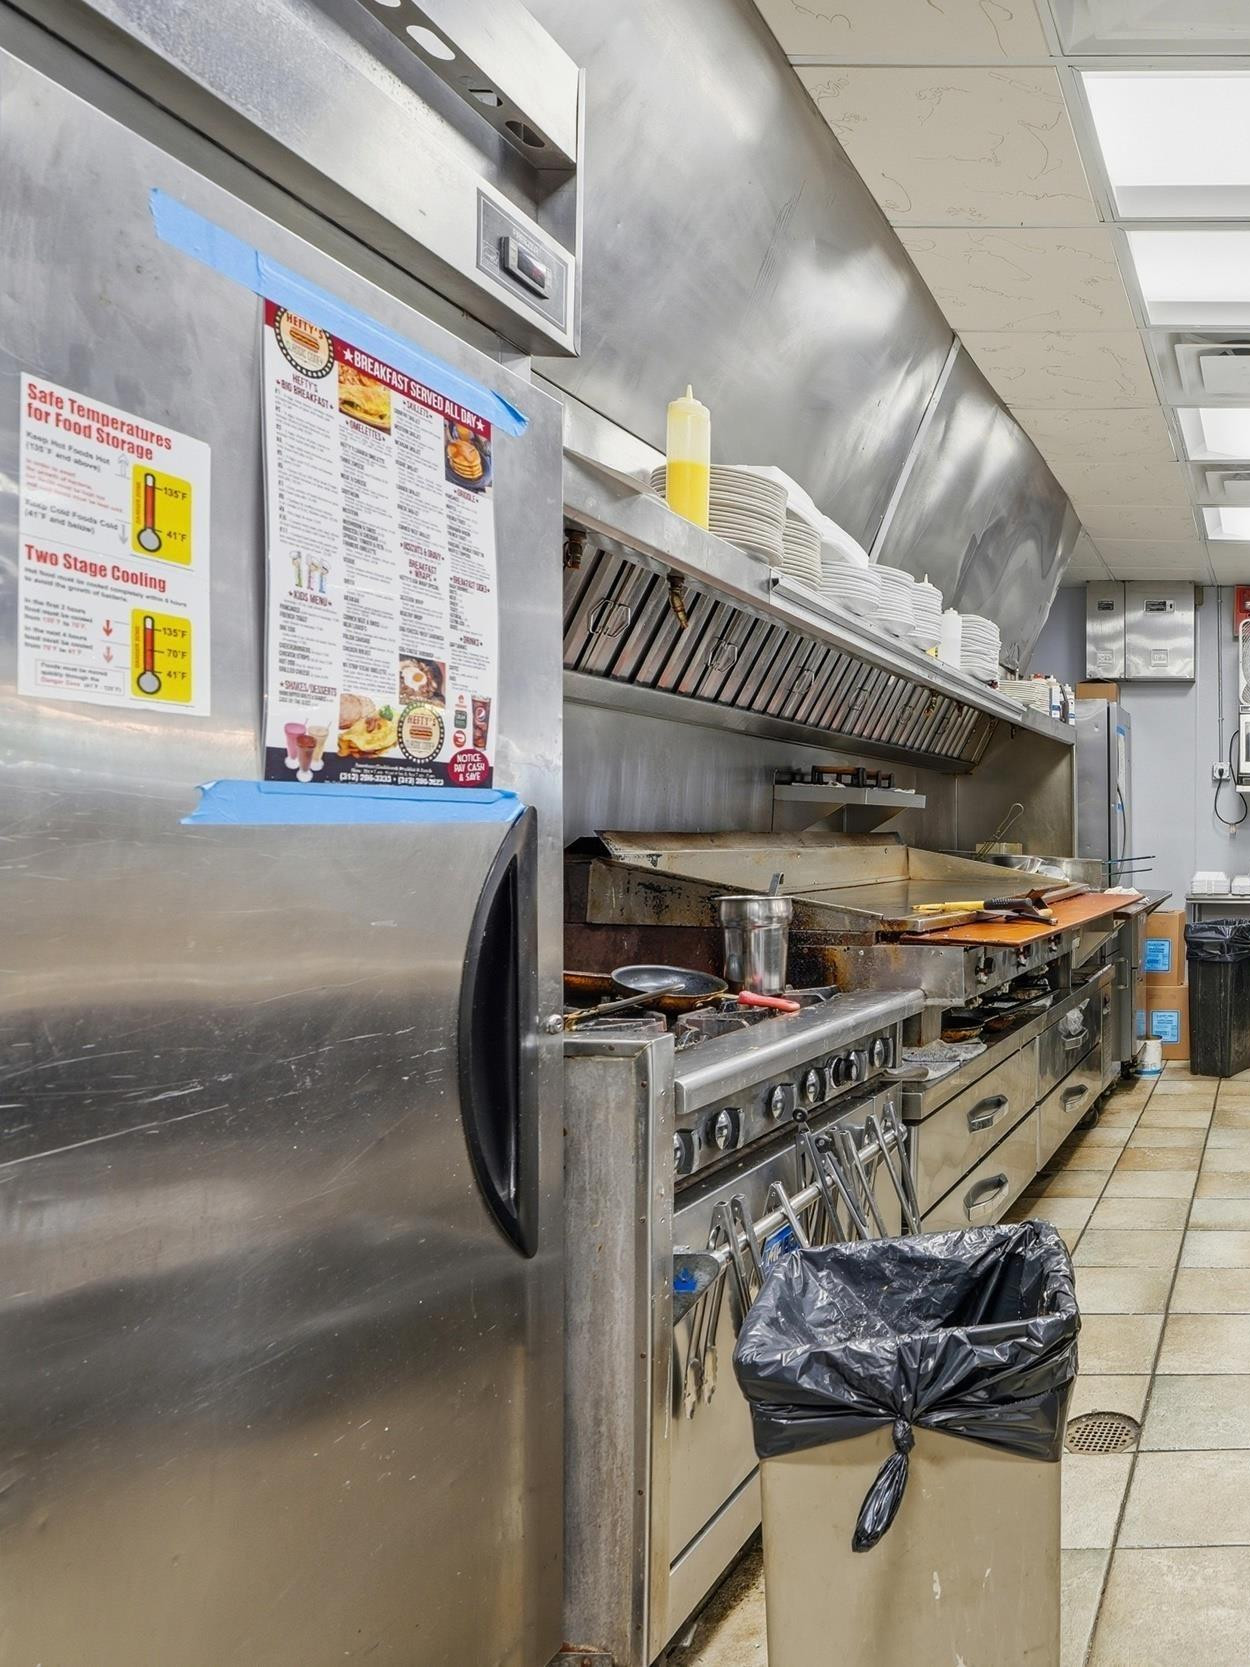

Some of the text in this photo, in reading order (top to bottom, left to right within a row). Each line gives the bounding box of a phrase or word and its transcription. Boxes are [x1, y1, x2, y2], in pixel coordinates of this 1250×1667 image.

[292, 373, 318, 393] HEFTY'S
[354, 350, 476, 428] BREAKFAST SERVED ALL DAY
[281, 380, 329, 408] BIG BREAKFAST
[27, 383, 172, 450] Safe Temperatures
[406, 400, 430, 419] SKILLETS
[27, 402, 153, 460] for Food Storage
[349, 420, 382, 442] OMELETTES
[26, 431, 111, 466] Keep Hot Foods Hot
[55, 452, 72, 463] and
[73, 457, 101, 474] above)
[163, 487, 188, 501] 135°F
[456, 488, 476, 503] GRIDDLE
[25, 499, 118, 531] Keep Cold Foods Cold
[50, 516, 66, 526] and
[67, 520, 95, 535] below)
[166, 531, 188, 542] 41°F
[403, 541, 423, 555] BISCUITS
[427, 549, 442, 560] GRAVY
[24, 544, 166, 594] Two Stage Cooling
[408, 559, 437, 575] BREAKFAST
[414, 570, 432, 582] WRAPS
[452, 575, 476, 589] BREAKFAST
[55, 580, 66, 590] the
[293, 590, 328, 607] KIDS MENU
[162, 627, 188, 639] 135°F
[463, 635, 480, 647] DRINKS
[166, 650, 188, 661] 70°F
[166, 671, 187, 681] 41°F
[407, 713, 437, 727] HEFTY'S
[454, 763, 485, 773] PAY CASH
[459, 773, 481, 782] & SAVE
